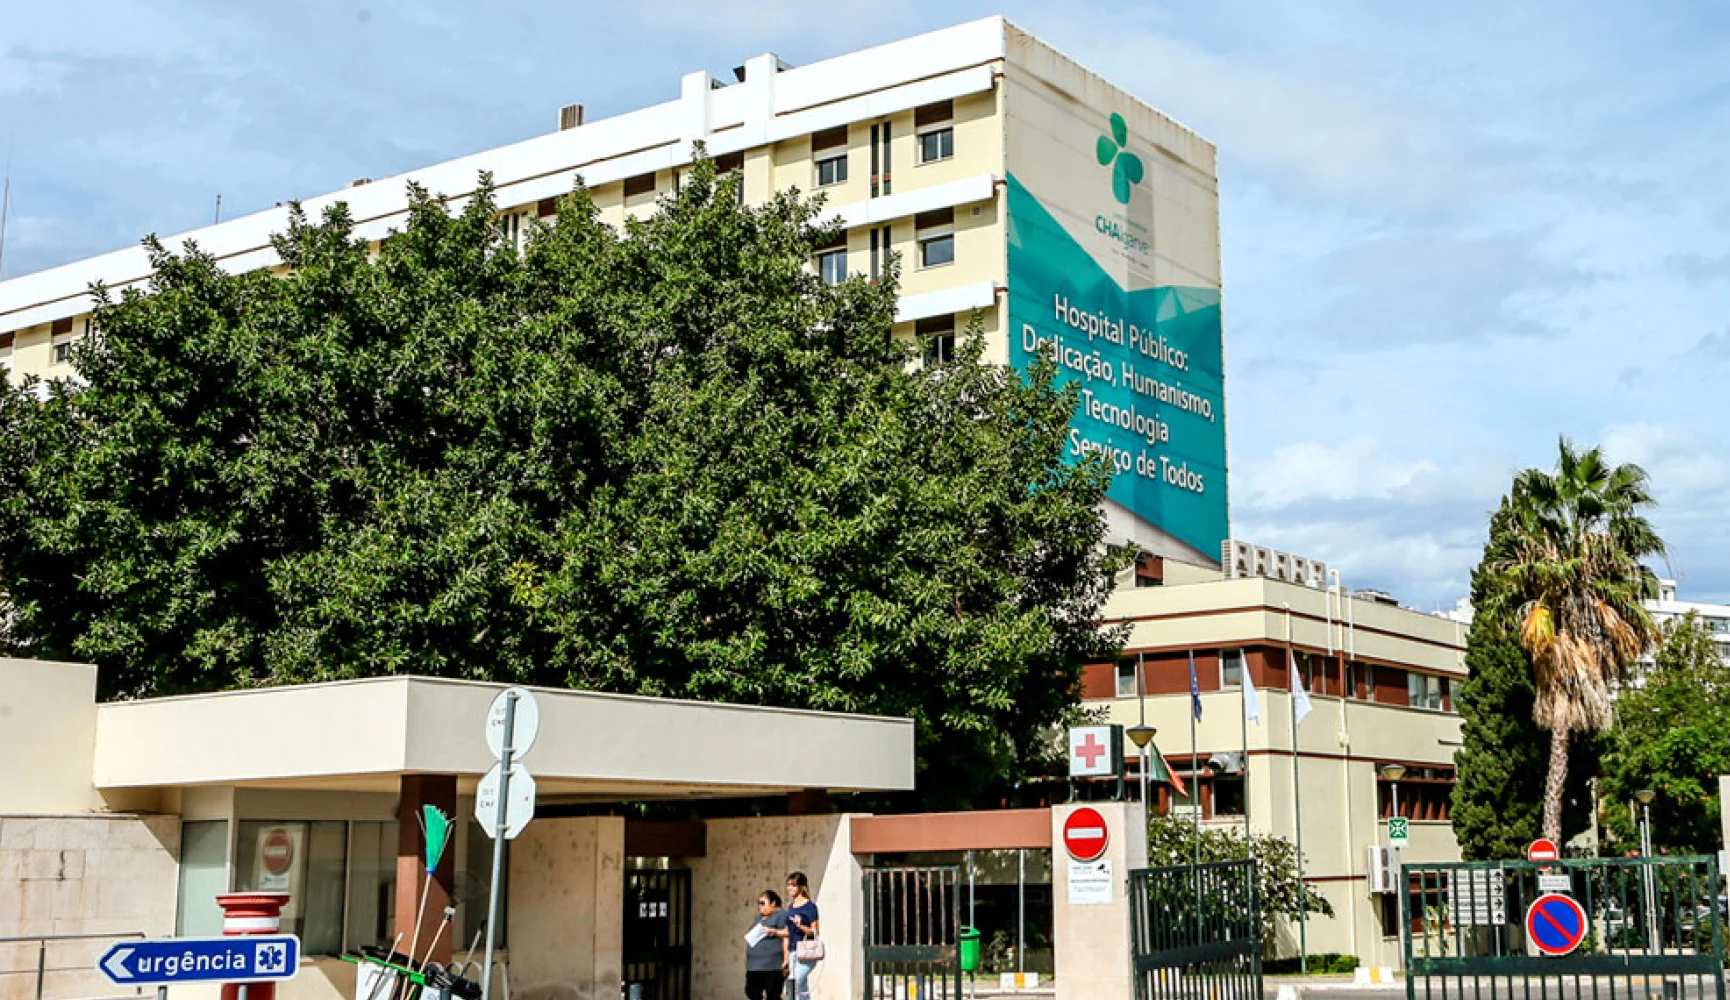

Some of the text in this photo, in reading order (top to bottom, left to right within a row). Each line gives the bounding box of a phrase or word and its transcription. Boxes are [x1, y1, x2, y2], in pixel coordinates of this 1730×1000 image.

[1054, 293, 1189, 372] Hospital Público:
[1082, 388, 1169, 446] Tecnologia
[1122, 361, 1215, 422] Humanismo,
[1136, 449, 1156, 479] de
[1159, 455, 1204, 493] Todos
[137, 949, 247, 976] urgência
